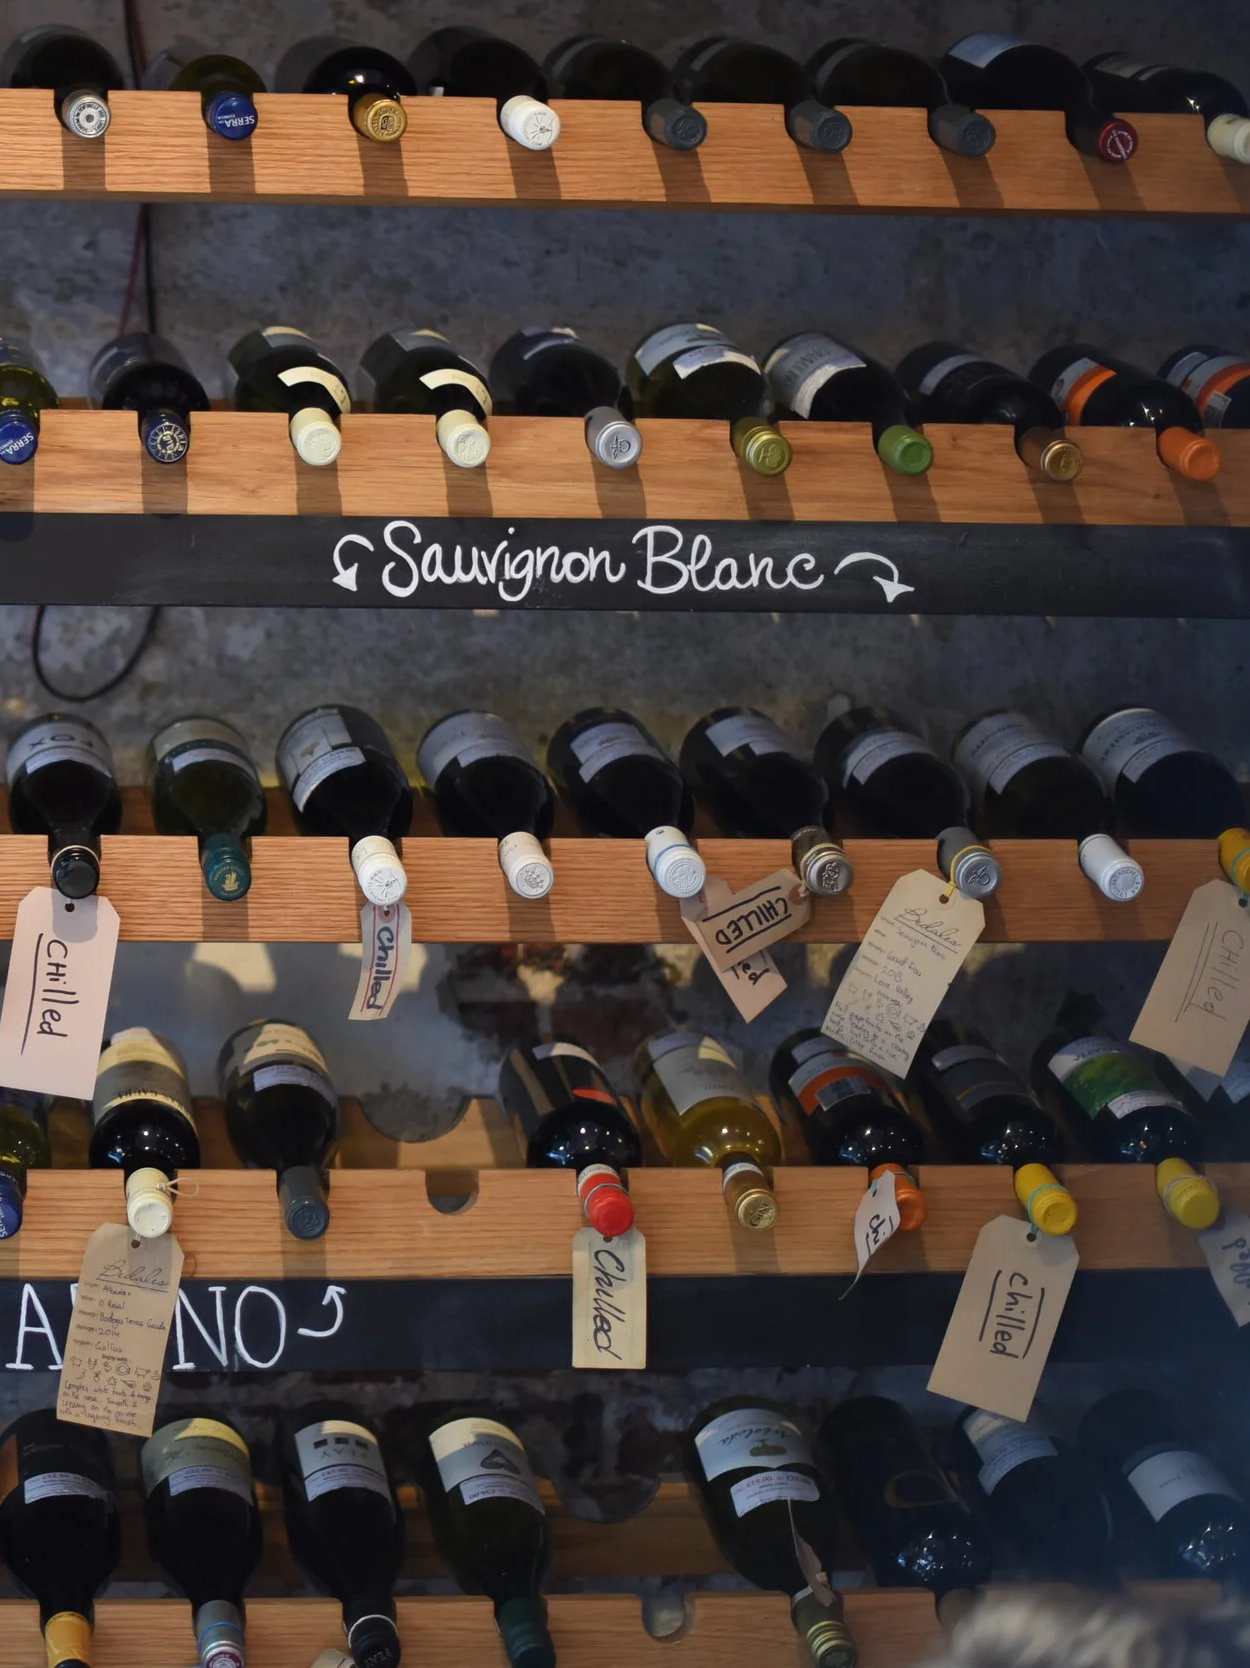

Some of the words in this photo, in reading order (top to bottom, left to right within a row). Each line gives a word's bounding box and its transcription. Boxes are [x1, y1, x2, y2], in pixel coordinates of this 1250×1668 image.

[225, 114, 256, 129] SERRA
[5, 431, 35, 456] SERRA
[381, 520, 626, 603] Sauvignon
[632, 525, 826, 596] Blanc
[715, 897, 789, 946] CHILLED
[591, 1248, 626, 1361] Chilled
